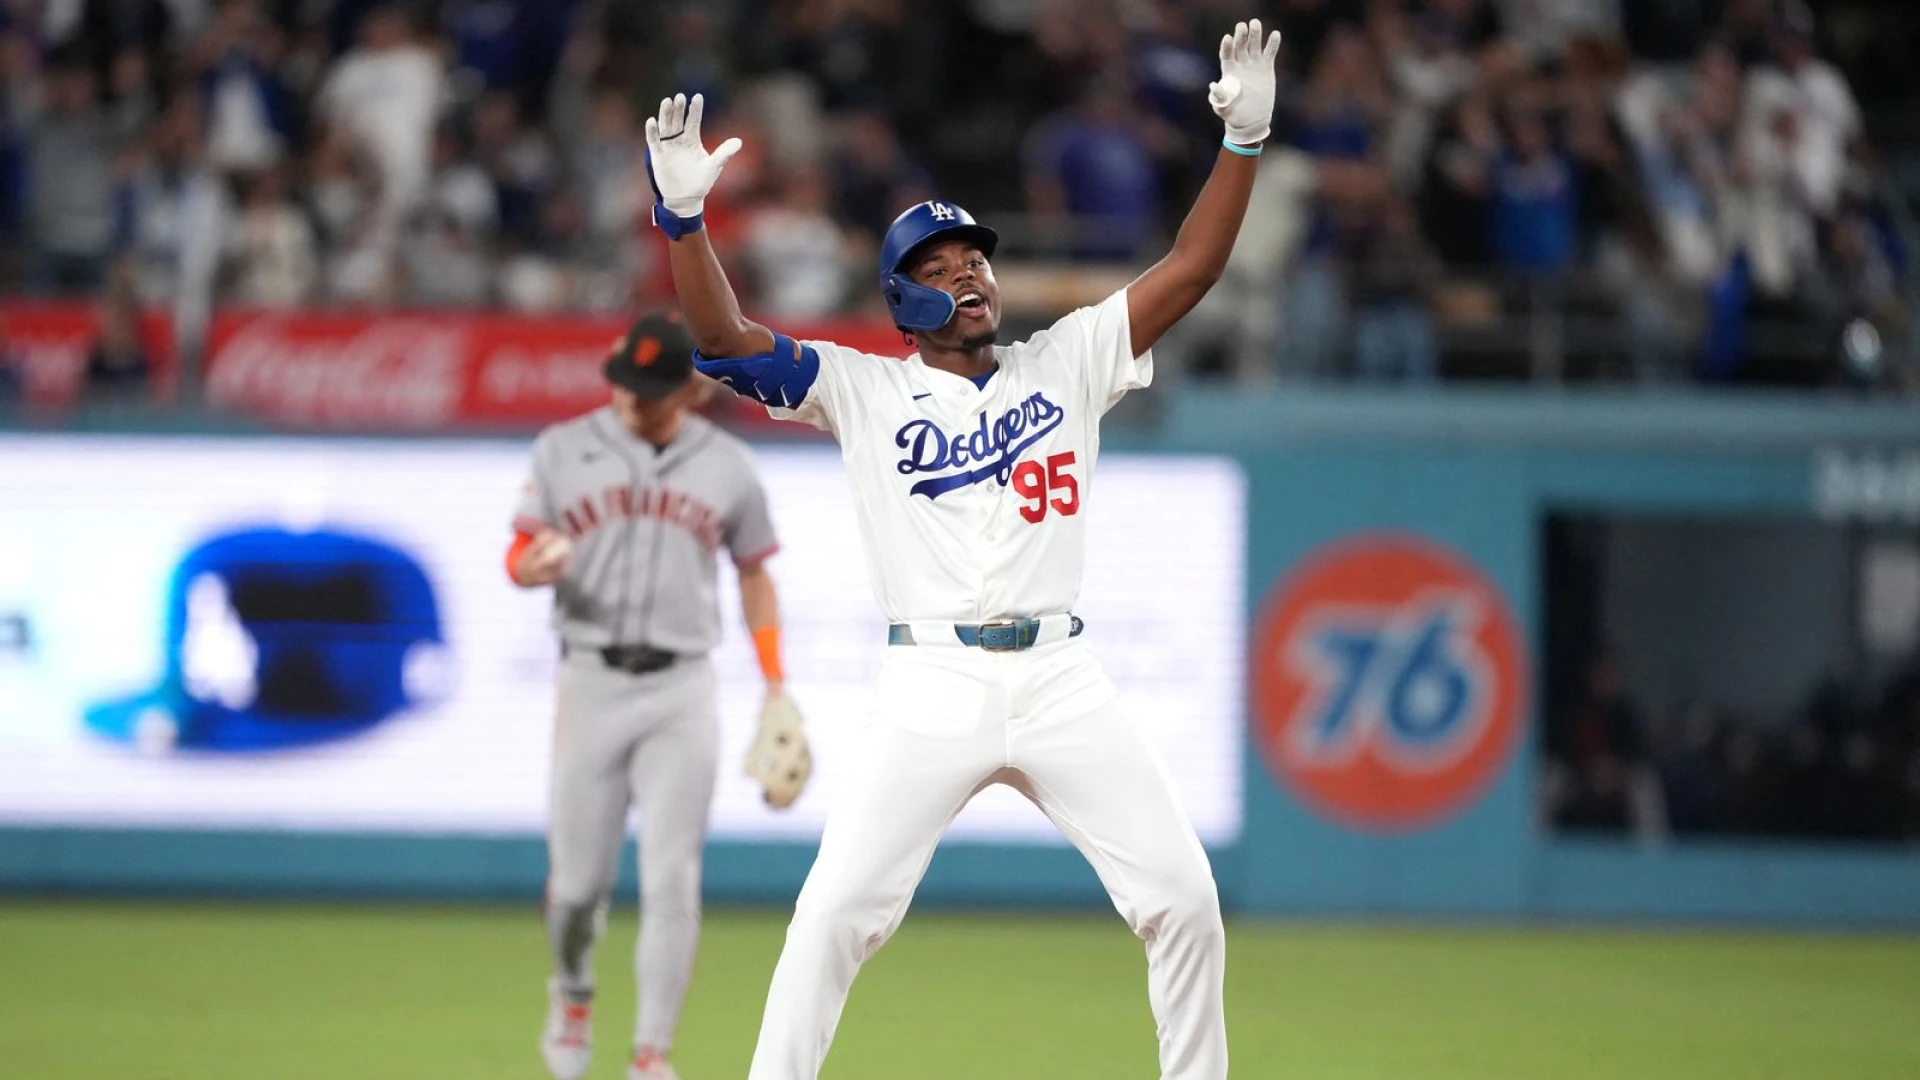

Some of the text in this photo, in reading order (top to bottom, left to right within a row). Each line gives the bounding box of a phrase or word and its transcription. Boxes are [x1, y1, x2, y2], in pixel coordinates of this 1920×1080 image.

[925, 200, 955, 221] LA
[895, 391, 1064, 501] Dodgers
[1011, 451, 1080, 524] 95
[1302, 600, 1484, 757] 76
